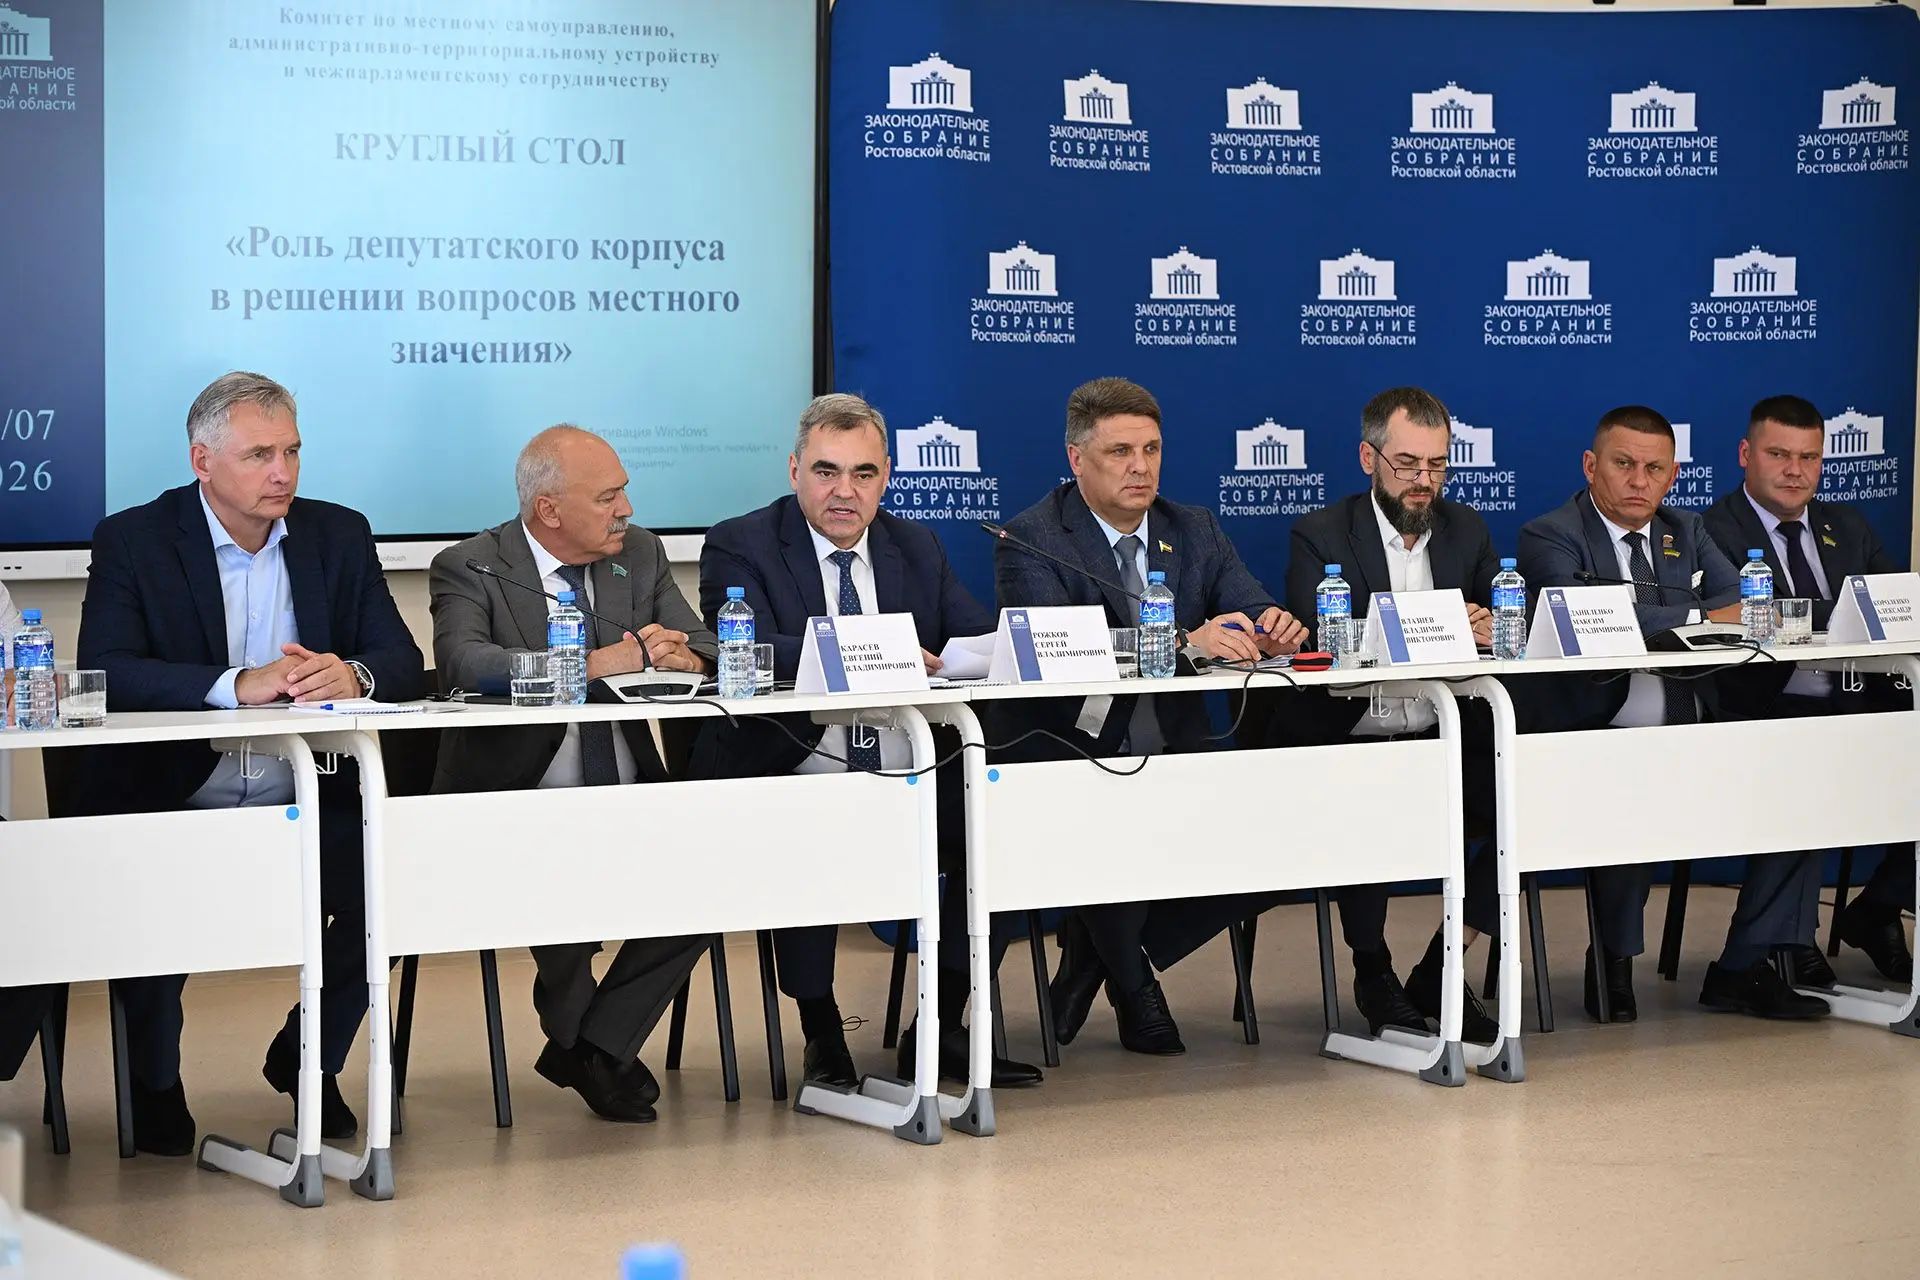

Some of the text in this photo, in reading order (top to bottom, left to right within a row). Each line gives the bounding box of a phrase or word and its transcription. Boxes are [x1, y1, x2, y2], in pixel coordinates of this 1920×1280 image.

[279, 7, 675, 38] Комитет по местному самоуправлению,
[228, 36, 720, 68] административно-территориальному устройству
[0, 66, 76, 80] АТЕЛЬНОЕ
[519, 71, 670, 92] сотрудничеству
[19, 96, 76, 111] области
[864, 114, 990, 132] ЗАКОНОДАТЕЛЬНОЕ
[864, 130, 990, 149] СОБРАНИЕ
[1049, 124, 1149, 143] ЗАКОНОДАТЕЛЬНОЕ
[1210, 133, 1320, 148] ЗАКОНОДАТЕЛЬНОЕ
[1797, 130, 1909, 147] ЗАКОНОДАТЕЛЬНОЕ
[334, 129, 627, 166] КРУГЛЫЙ СТОЛ
[1050, 140, 1149, 158] СОБРАНИЕ
[1391, 136, 1516, 152] ЗАКОНОДАТЕЛЬНОЕ
[1587, 136, 1718, 152] ЗАКОНОДАТЕЛЬНОЕ
[864, 144, 991, 162] Ростовской области
[1210, 148, 1320, 163] СОБРАНИЕ
[1391, 152, 1516, 165] СОБРАНИЕ
[1587, 150, 1718, 165] СОБРАНИЕ
[1797, 144, 1908, 161] СОБРАНИЕ
[1050, 154, 1150, 171] Ростовской области
[1211, 162, 1321, 176] Ростовской области
[1797, 158, 1908, 174] Ростовской области
[1392, 164, 1516, 178] Ростовской области
[1588, 163, 1718, 178] Ростовской области
[226, 226, 726, 270] «Роль депутатского корпуса
[210, 288, 740, 321] в решении вопросов местного
[971, 298, 1074, 315] ЗАКОНОДАТЕЛЬНОЕ
[1134, 303, 1236, 318] ЗАКОНОДАТЕЛЬНОЕ
[1300, 304, 1416, 319] ЗАКОНОДАТЕЛЬНОЕ
[1484, 304, 1612, 319] ЗАКОНОДАТЕЛЬНОЕ
[1690, 300, 1817, 315] ЗАКОНОДАТЕЛЬНОЕ
[970, 313, 1074, 330] СОБРАНИЕ
[1134, 319, 1236, 332] СОБРАНИЕ
[1301, 319, 1416, 332] СОБРАНИЕ
[1484, 318, 1612, 333] СОБРАНИЕ
[1690, 314, 1817, 329] СОБРАНИЕ
[971, 329, 1076, 344] Ростовской области
[1135, 332, 1237, 346] Ростовской области
[1301, 333, 1416, 346] Ростовской области
[1484, 332, 1612, 345] Ростовской области
[1690, 328, 1817, 341] Ростовской области
[390, 340, 573, 364] значения»
[655, 424, 709, 438] Windows
[1822, 457, 1898, 476] НОДАТЕЛЬНОЕ
[0, 459, 53, 491] 26
[1219, 473, 1325, 489] ЗАКОНОДАТЕЛЬНОЕ
[1449, 471, 1515, 484] АТЕЛЬНОЕ
[1823, 471, 1898, 489] БРАНИЕ
[886, 476, 998, 491] АКОНОДАТЕЛЬНОЕ
[879, 493, 999, 506] ОБРАНИЕ
[1219, 488, 1325, 503] СОБРАНИЕ
[1442, 486, 1516, 498] РАНИЕ
[1813, 487, 1898, 502] овской области
[886, 506, 1000, 520] стовской области
[1220, 502, 1280, 516] Ростовской
[1032, 631, 1069, 639] РОЖКОВ
[840, 643, 880, 652] КАРАСЕВ
[1034, 640, 1068, 649] СЕРГЕЙ
[842, 652, 883, 662] ЕВГЕНИЙ
